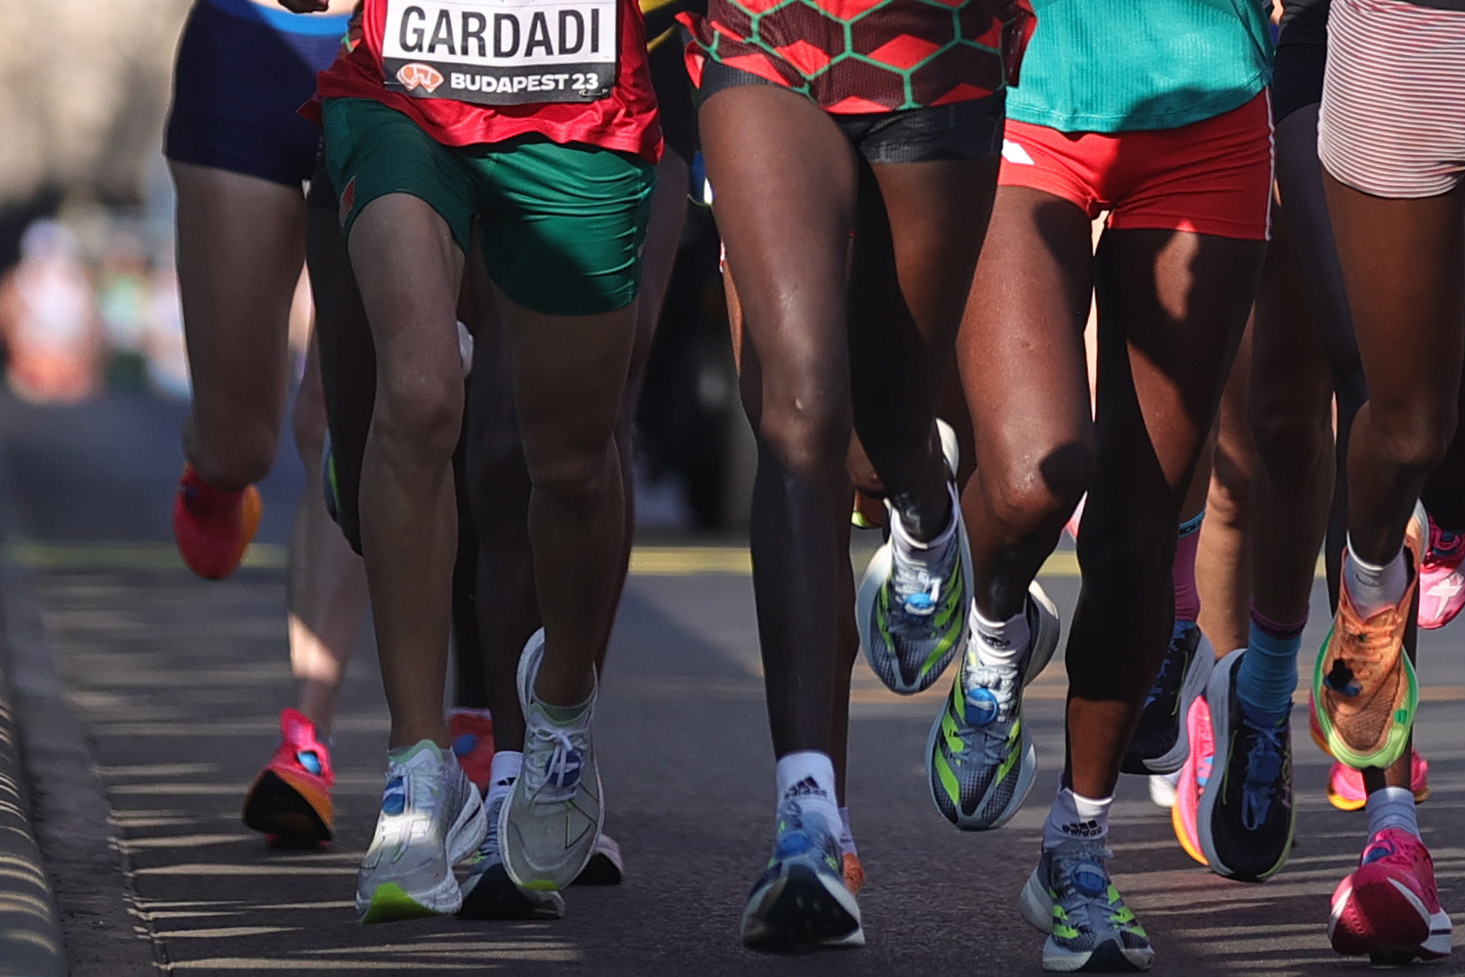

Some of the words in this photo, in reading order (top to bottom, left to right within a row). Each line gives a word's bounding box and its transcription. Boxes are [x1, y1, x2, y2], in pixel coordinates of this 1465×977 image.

[399, 5, 600, 59] GARDADI
[450, 72, 570, 93] BUDAPEST
[572, 72, 599, 90] 23
